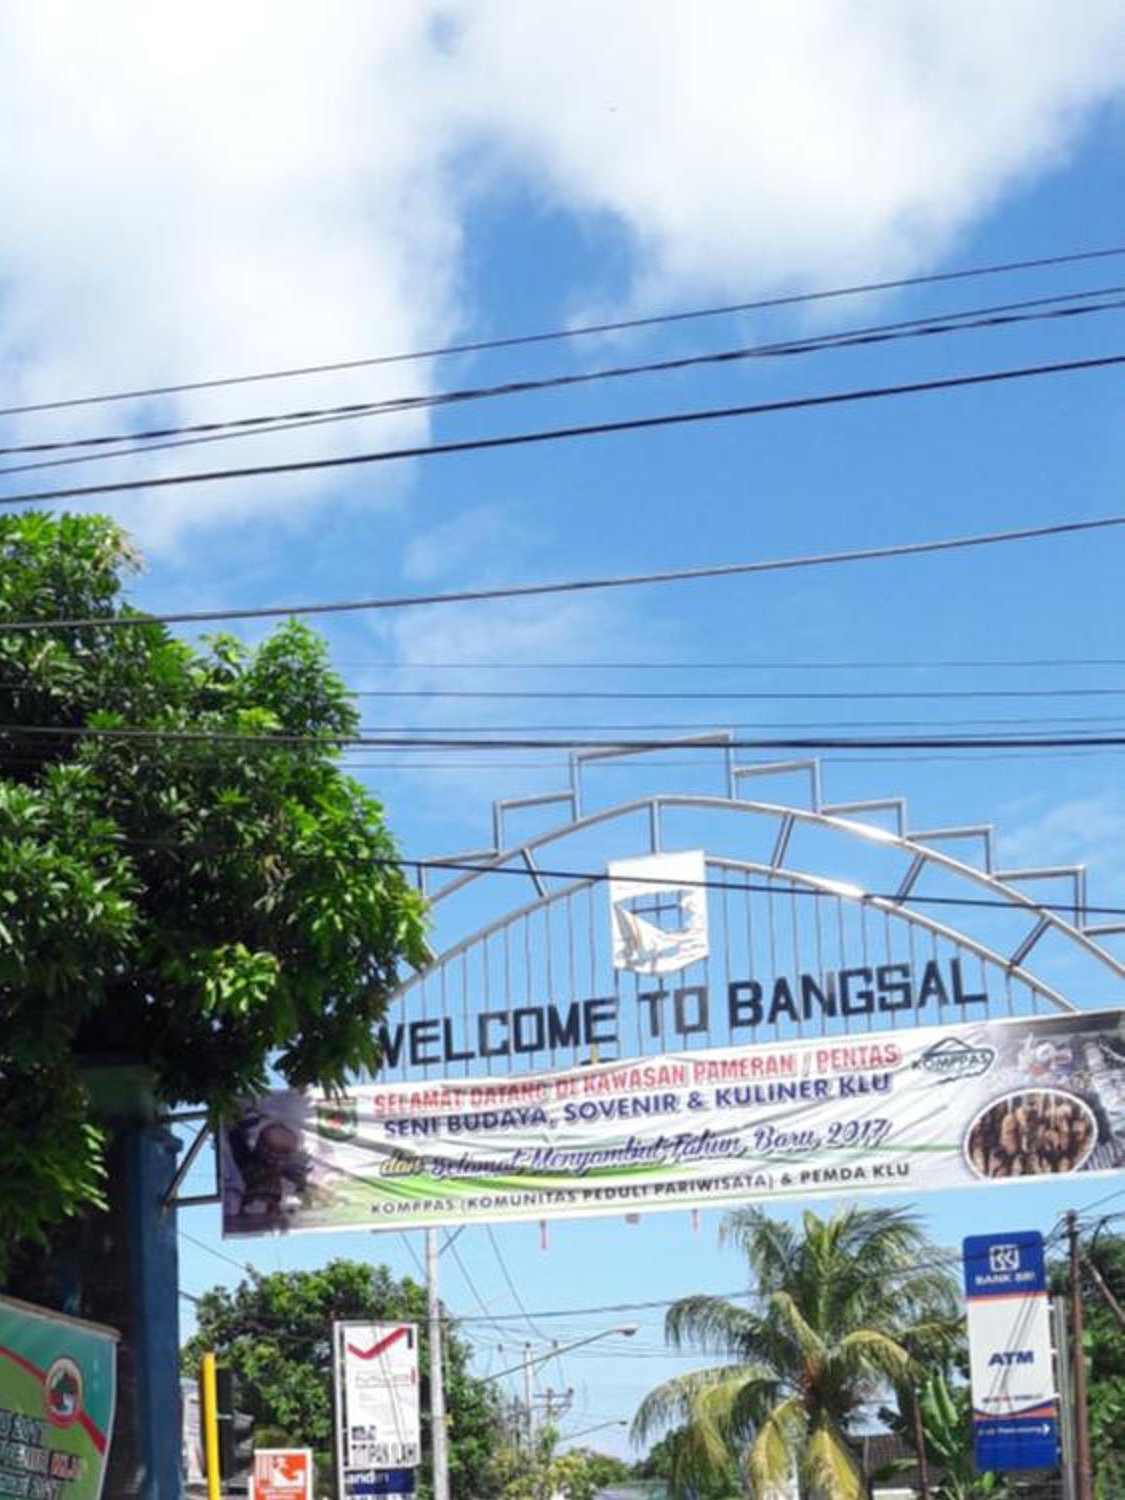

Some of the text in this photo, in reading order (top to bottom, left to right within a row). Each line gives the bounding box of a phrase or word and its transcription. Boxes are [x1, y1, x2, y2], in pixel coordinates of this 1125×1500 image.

[378, 957, 988, 1069] WELCOME TO BANGSAL
[584, 1063, 685, 1096] KAWASAN
[693, 1053, 794, 1084] PAMERAN
[816, 1044, 900, 1071] PENTAS
[385, 1118, 437, 1137] SENI
[564, 1094, 675, 1122] SOVENIR
[687, 1092, 704, 1110] &
[715, 1080, 829, 1108] KULINER
[839, 1073, 892, 1096] KLU
[582, 1182, 649, 1201] PEDULI
[653, 1173, 774, 1197] PARIWISATA)
[780, 1174, 793, 1187] &
[800, 1167, 866, 1185] PEMDA
[873, 1162, 911, 1179] KLU
[988, 1350, 1035, 1367] ATM
